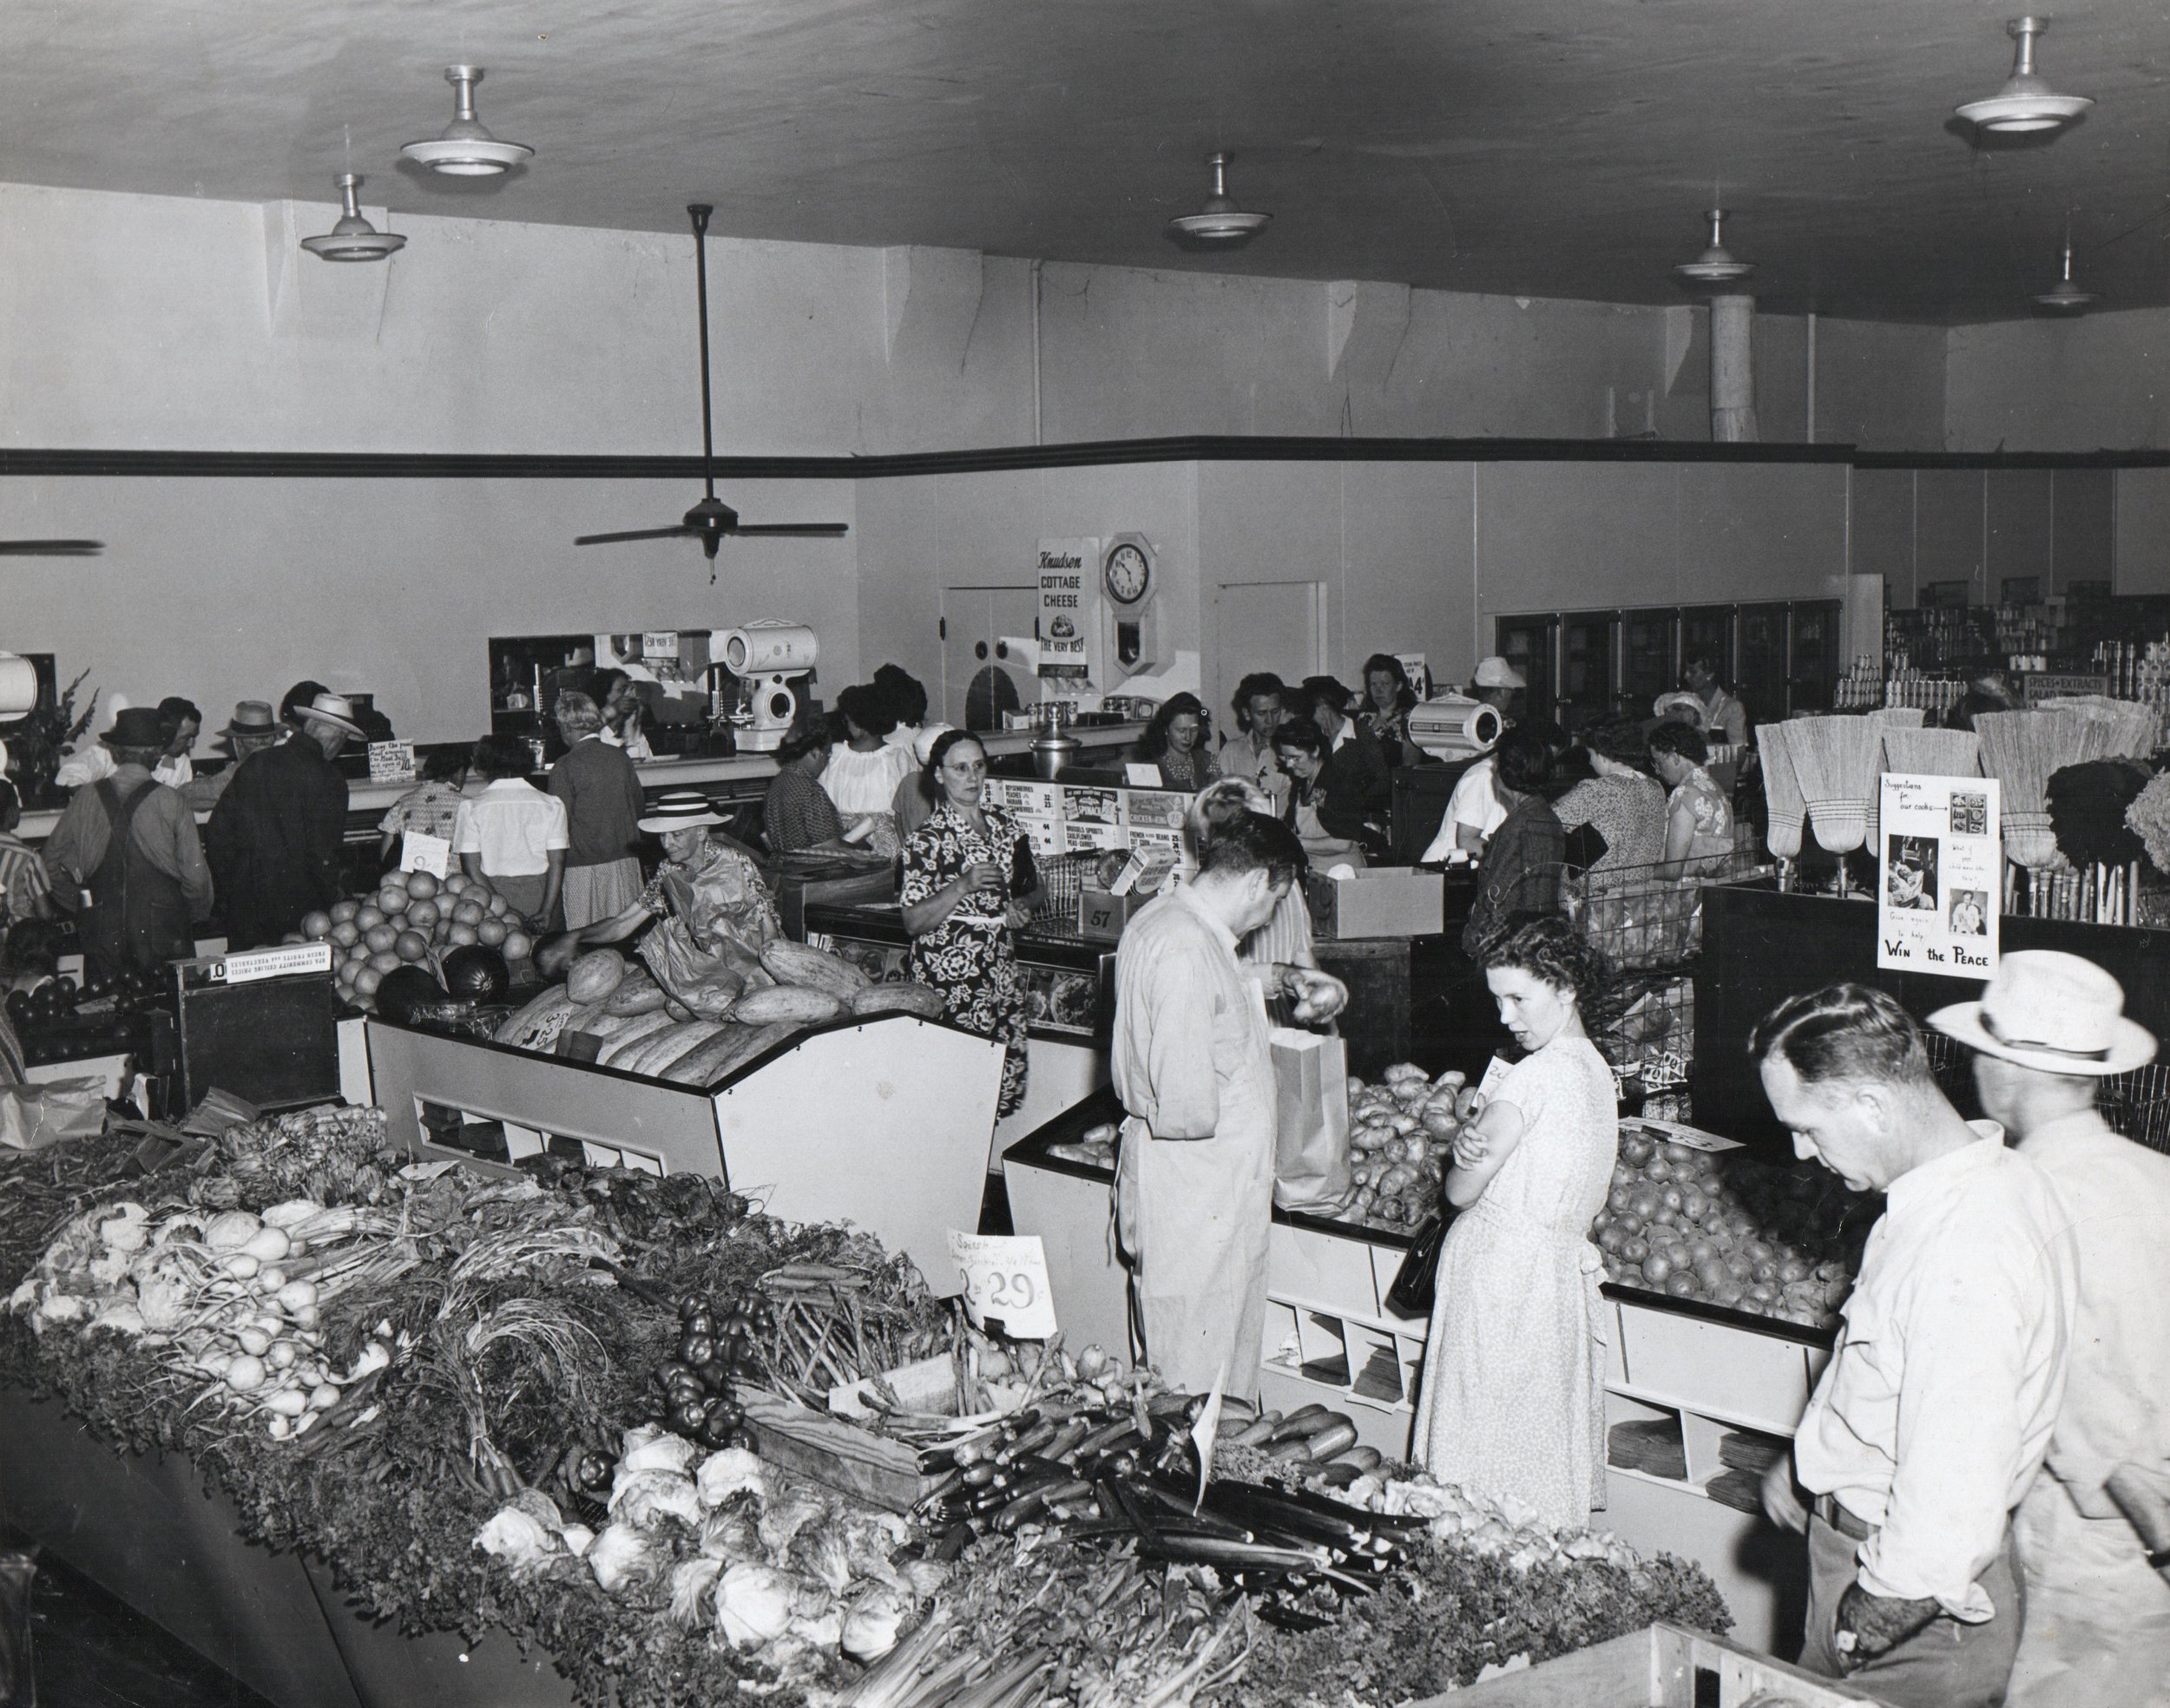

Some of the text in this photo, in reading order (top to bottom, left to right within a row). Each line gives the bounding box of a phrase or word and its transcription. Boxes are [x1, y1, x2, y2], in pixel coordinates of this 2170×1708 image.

[1038, 551, 1082, 568] Knudsen
[1041, 576, 1080, 588] COTTAGE
[1044, 595, 1078, 608] CHEESE
[1041, 636, 1083, 653] THE VERY BEST
[2029, 677, 2102, 689] SPICES EXTRACTS
[1884, 778, 1922, 791] Suggestions
[1899, 792, 1908, 803] for
[1078, 805, 1101, 817] SPINACH
[1090, 910, 1111, 929] 57
[1911, 930, 1924, 941] help
[230, 958, 268, 968] VEGETABLES
[279, 959, 312, 969] COMMUNITY
[988, 1271, 1035, 1309] 29
